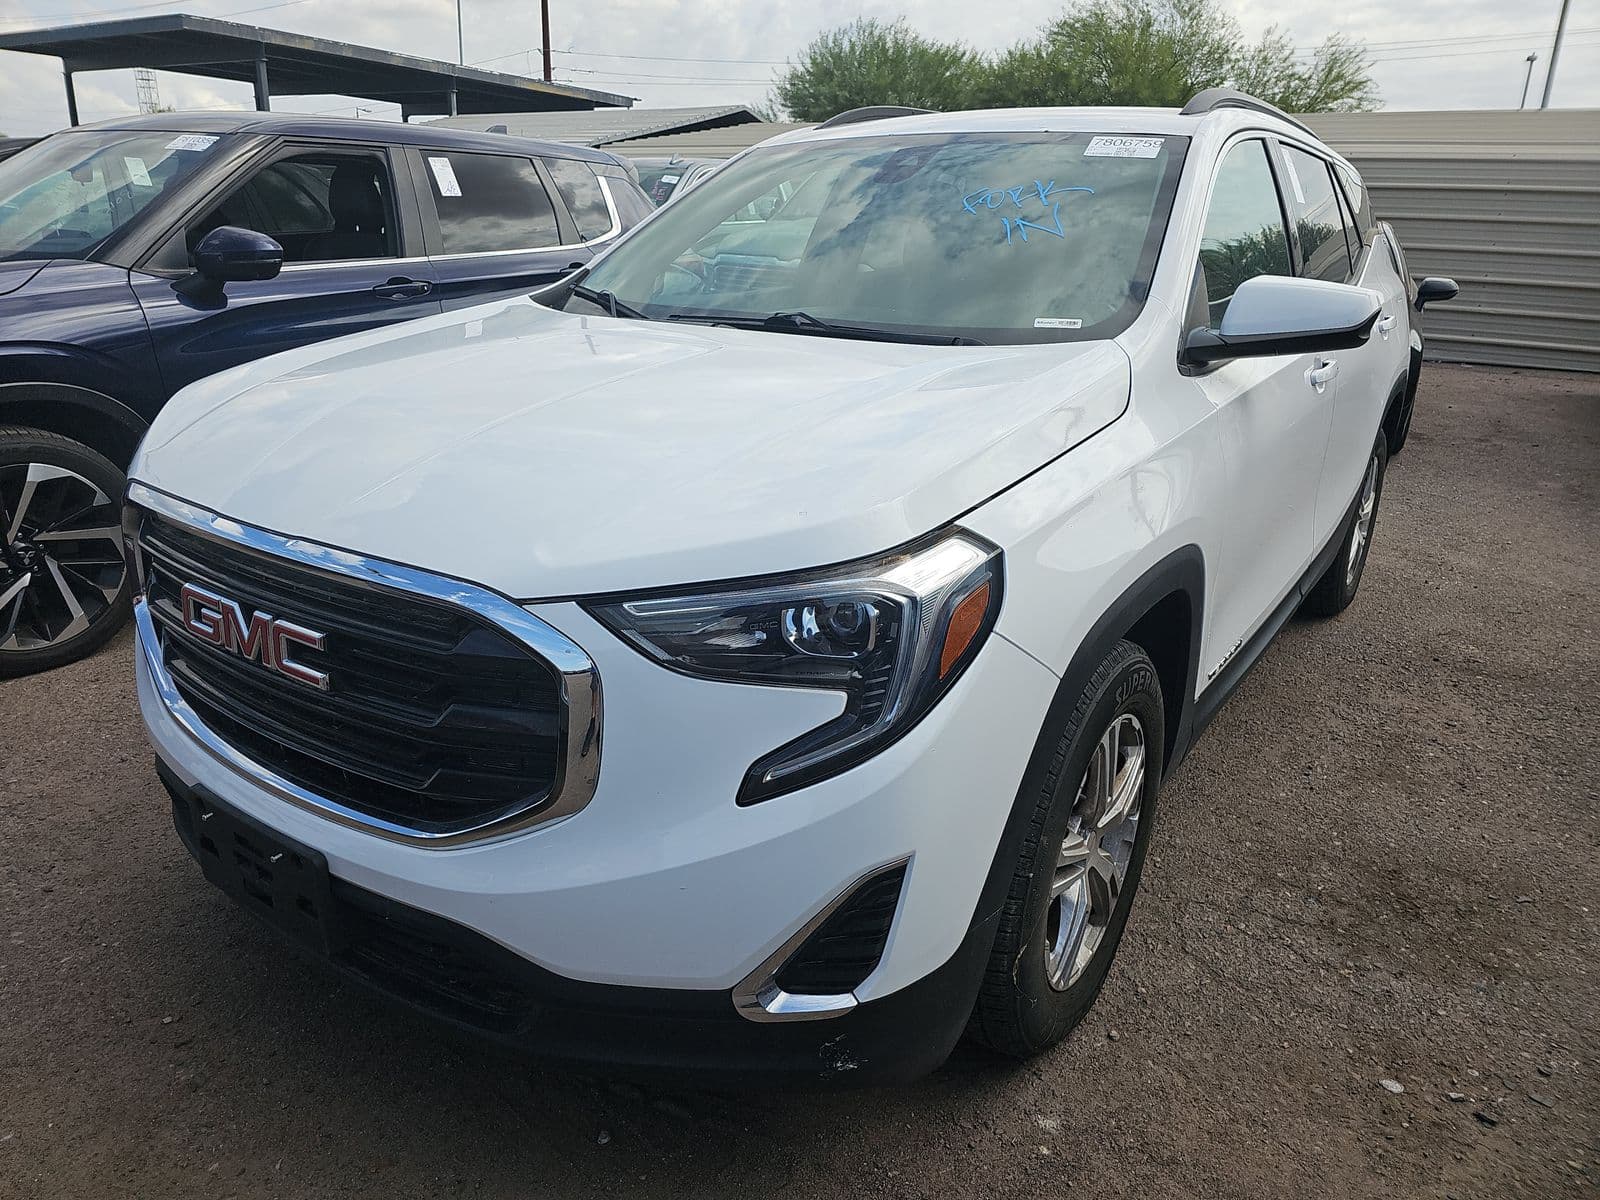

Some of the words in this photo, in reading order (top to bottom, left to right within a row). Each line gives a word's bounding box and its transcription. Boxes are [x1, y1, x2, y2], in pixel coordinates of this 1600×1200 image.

[1094, 138, 1163, 149] 7806759
[1001, 201, 1065, 246] IN
[182, 582, 330, 691] GMC
